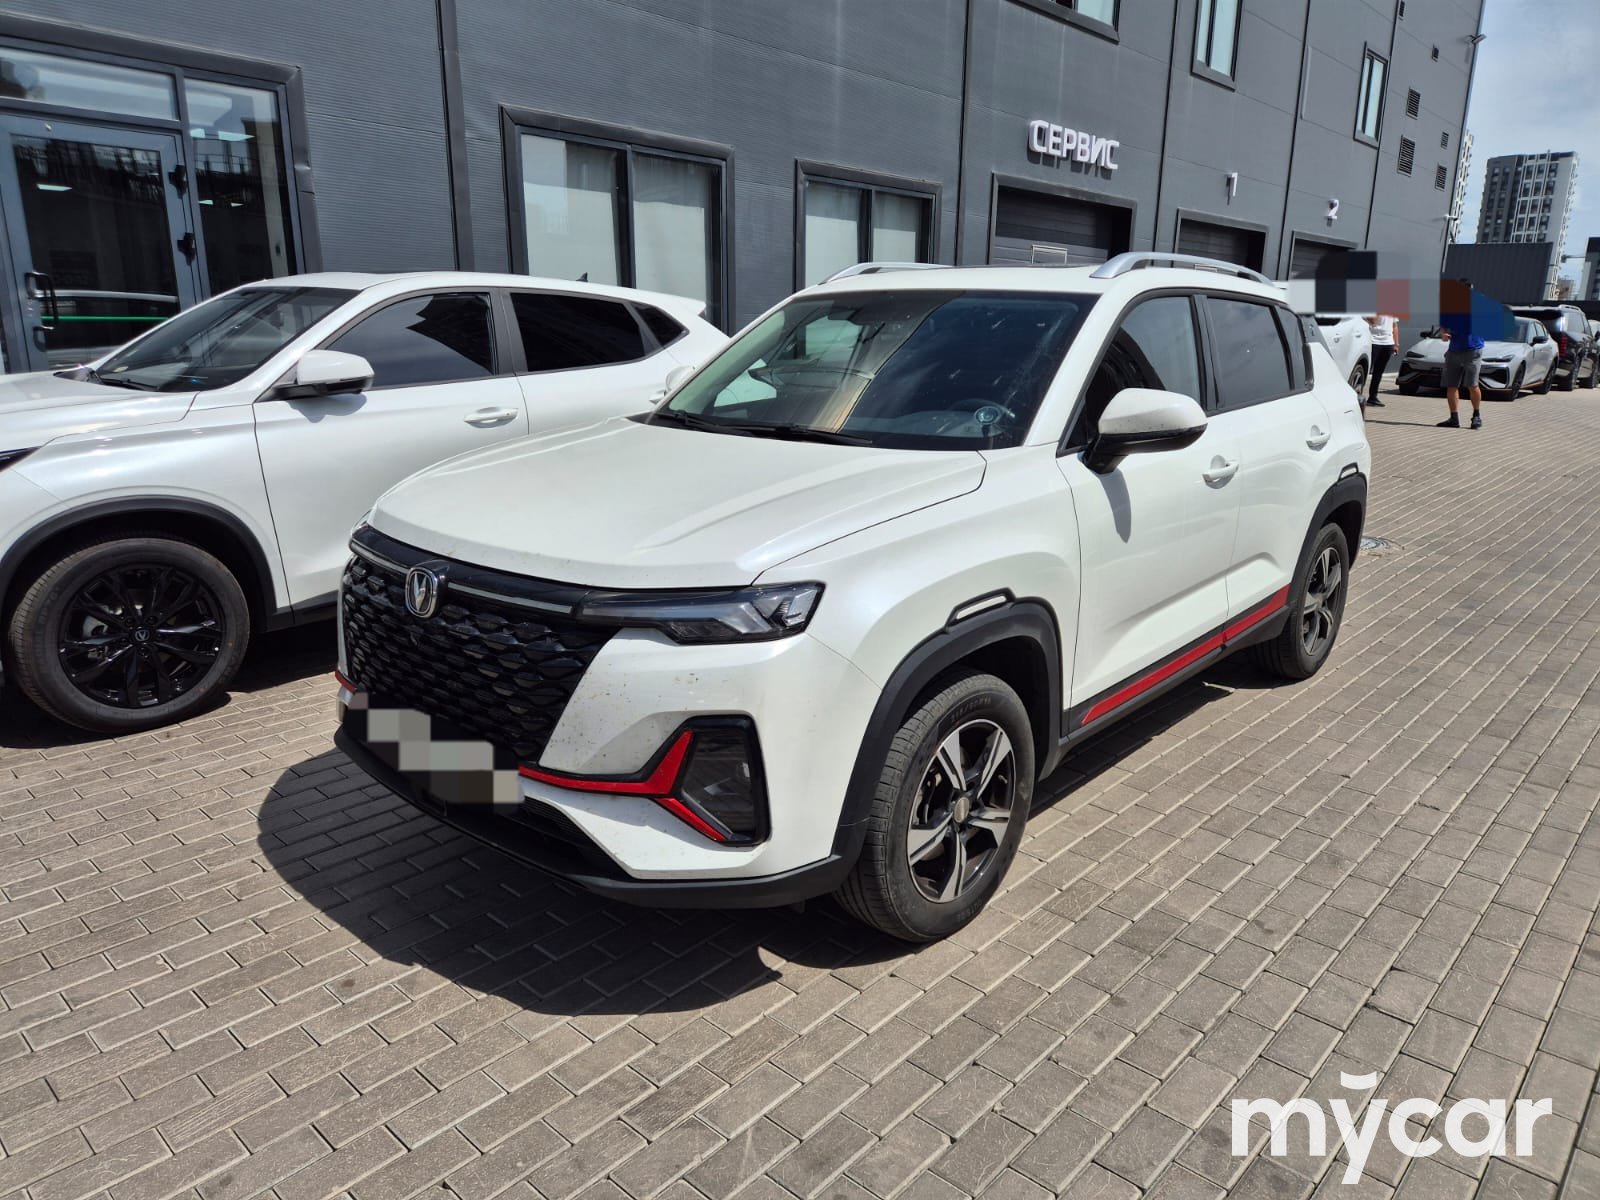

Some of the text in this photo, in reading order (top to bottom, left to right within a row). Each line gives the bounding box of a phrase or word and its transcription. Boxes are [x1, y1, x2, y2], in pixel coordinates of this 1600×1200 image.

[1028, 120, 1120, 170] СЕРВИС
[1230, 172, 1238, 197] 1
[1328, 199, 1339, 220] 2
